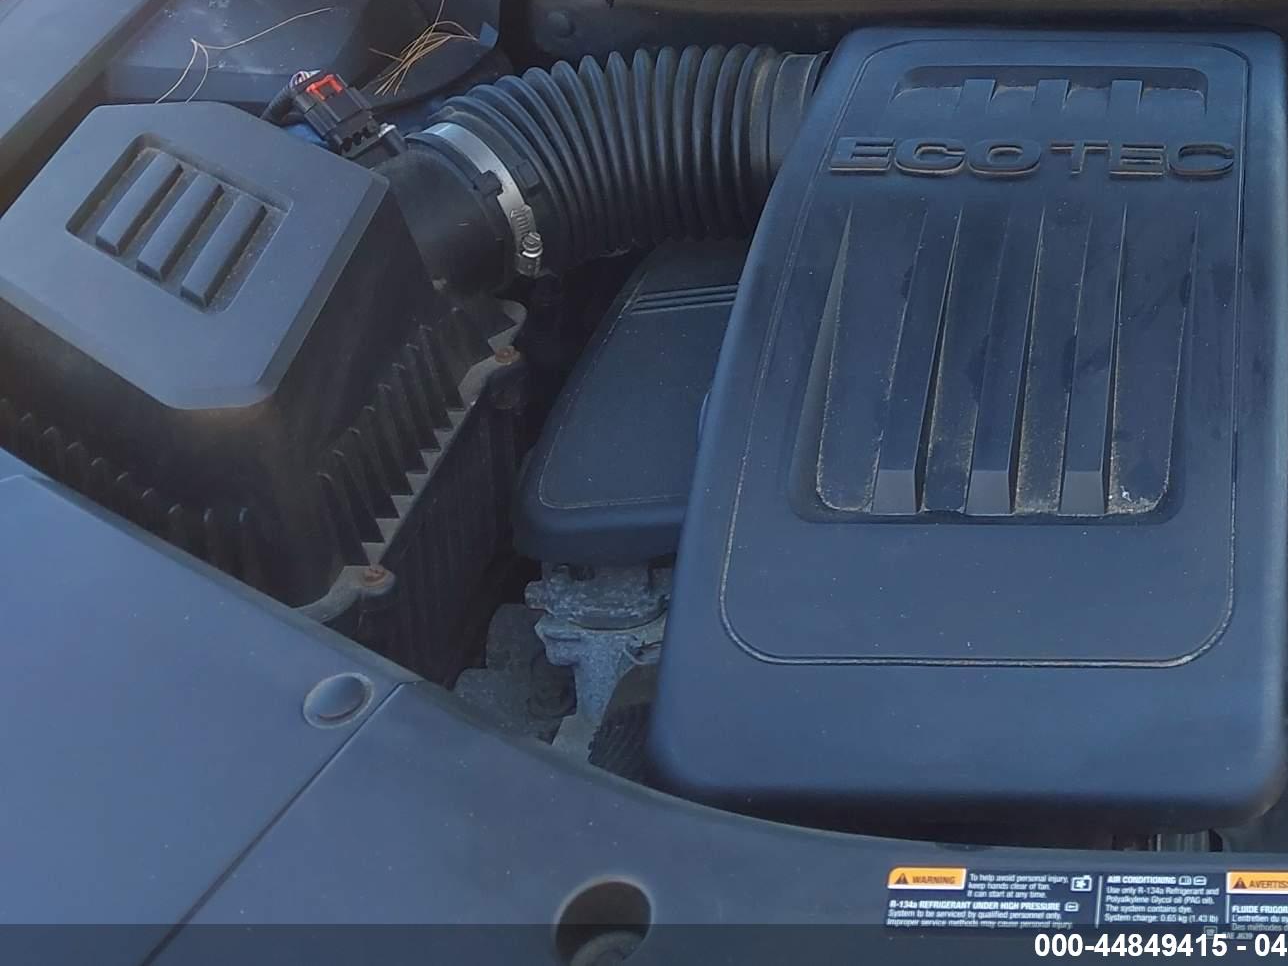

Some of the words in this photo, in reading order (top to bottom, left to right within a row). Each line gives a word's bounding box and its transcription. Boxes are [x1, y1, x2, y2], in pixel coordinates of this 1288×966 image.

[827, 136, 1235, 178] ECOTEC
[912, 875, 956, 885] WARNING
[969, 873, 978, 882] To
[980, 874, 995, 883] help
[996, 874, 1016, 882] avoid
[1016, 875, 1047, 883] personal
[1106, 875, 1121, 884] AIR
[1122, 875, 1177, 884] CONDITIONING
[967, 882, 986, 891] keep
[987, 882, 1009, 890] hands
[1010, 882, 1028, 890] clear
[1028, 882, 1037, 890] of
[1106, 886, 1120, 894] Use
[1121, 887, 1136, 895] only
[1137, 887, 1164, 895] R-134a
[1165, 887, 1205, 896] Refrigerant
[1205, 887, 1220, 895] and
[1015, 891, 1028, 899] any
[1105, 895, 1150, 904] Polyalkylene
[1151, 896, 1172, 905] Glycol
[1173, 896, 1183, 904] oil
[1183, 896, 1201, 905] (PAG
[889, 899, 918, 909] R-134a
[919, 900, 972, 910] REFRIGERANT
[972, 901, 999, 910] UNDER
[999, 901, 1020, 910] HIGH
[1020, 901, 1061, 911] PRESSURE
[1105, 904, 1119, 912] The
[1120, 905, 1146, 914] system
[1147, 905, 1177, 913] contains
[1232, 905, 1258, 914] FLUIDE
[887, 909, 916, 918] System
[916, 910, 924, 918] to
[925, 910, 935, 918] be
[936, 910, 967, 918] serviced
[967, 911, 976, 920] by
[977, 911, 1009, 920] qualified
[1009, 912, 1044, 920] personnel
[1104, 913, 1132, 923] System
[1160, 914, 1177, 922] 0.65
[1178, 914, 1188, 924] kg
[1188, 914, 1208, 924] (1.43
[1209, 914, 1219, 924] lb)
[1232, 914, 1269, 923] L'entretien
[1270, 915, 1280, 923] du
[886, 918, 920, 928] Improper
[920, 919, 947, 927] service
[948, 919, 979, 927] methods
[980, 920, 996, 929] may
[997, 920, 1019, 928] cause
[1020, 920, 1052, 929] personal
[1232, 922, 1246, 931] Des
